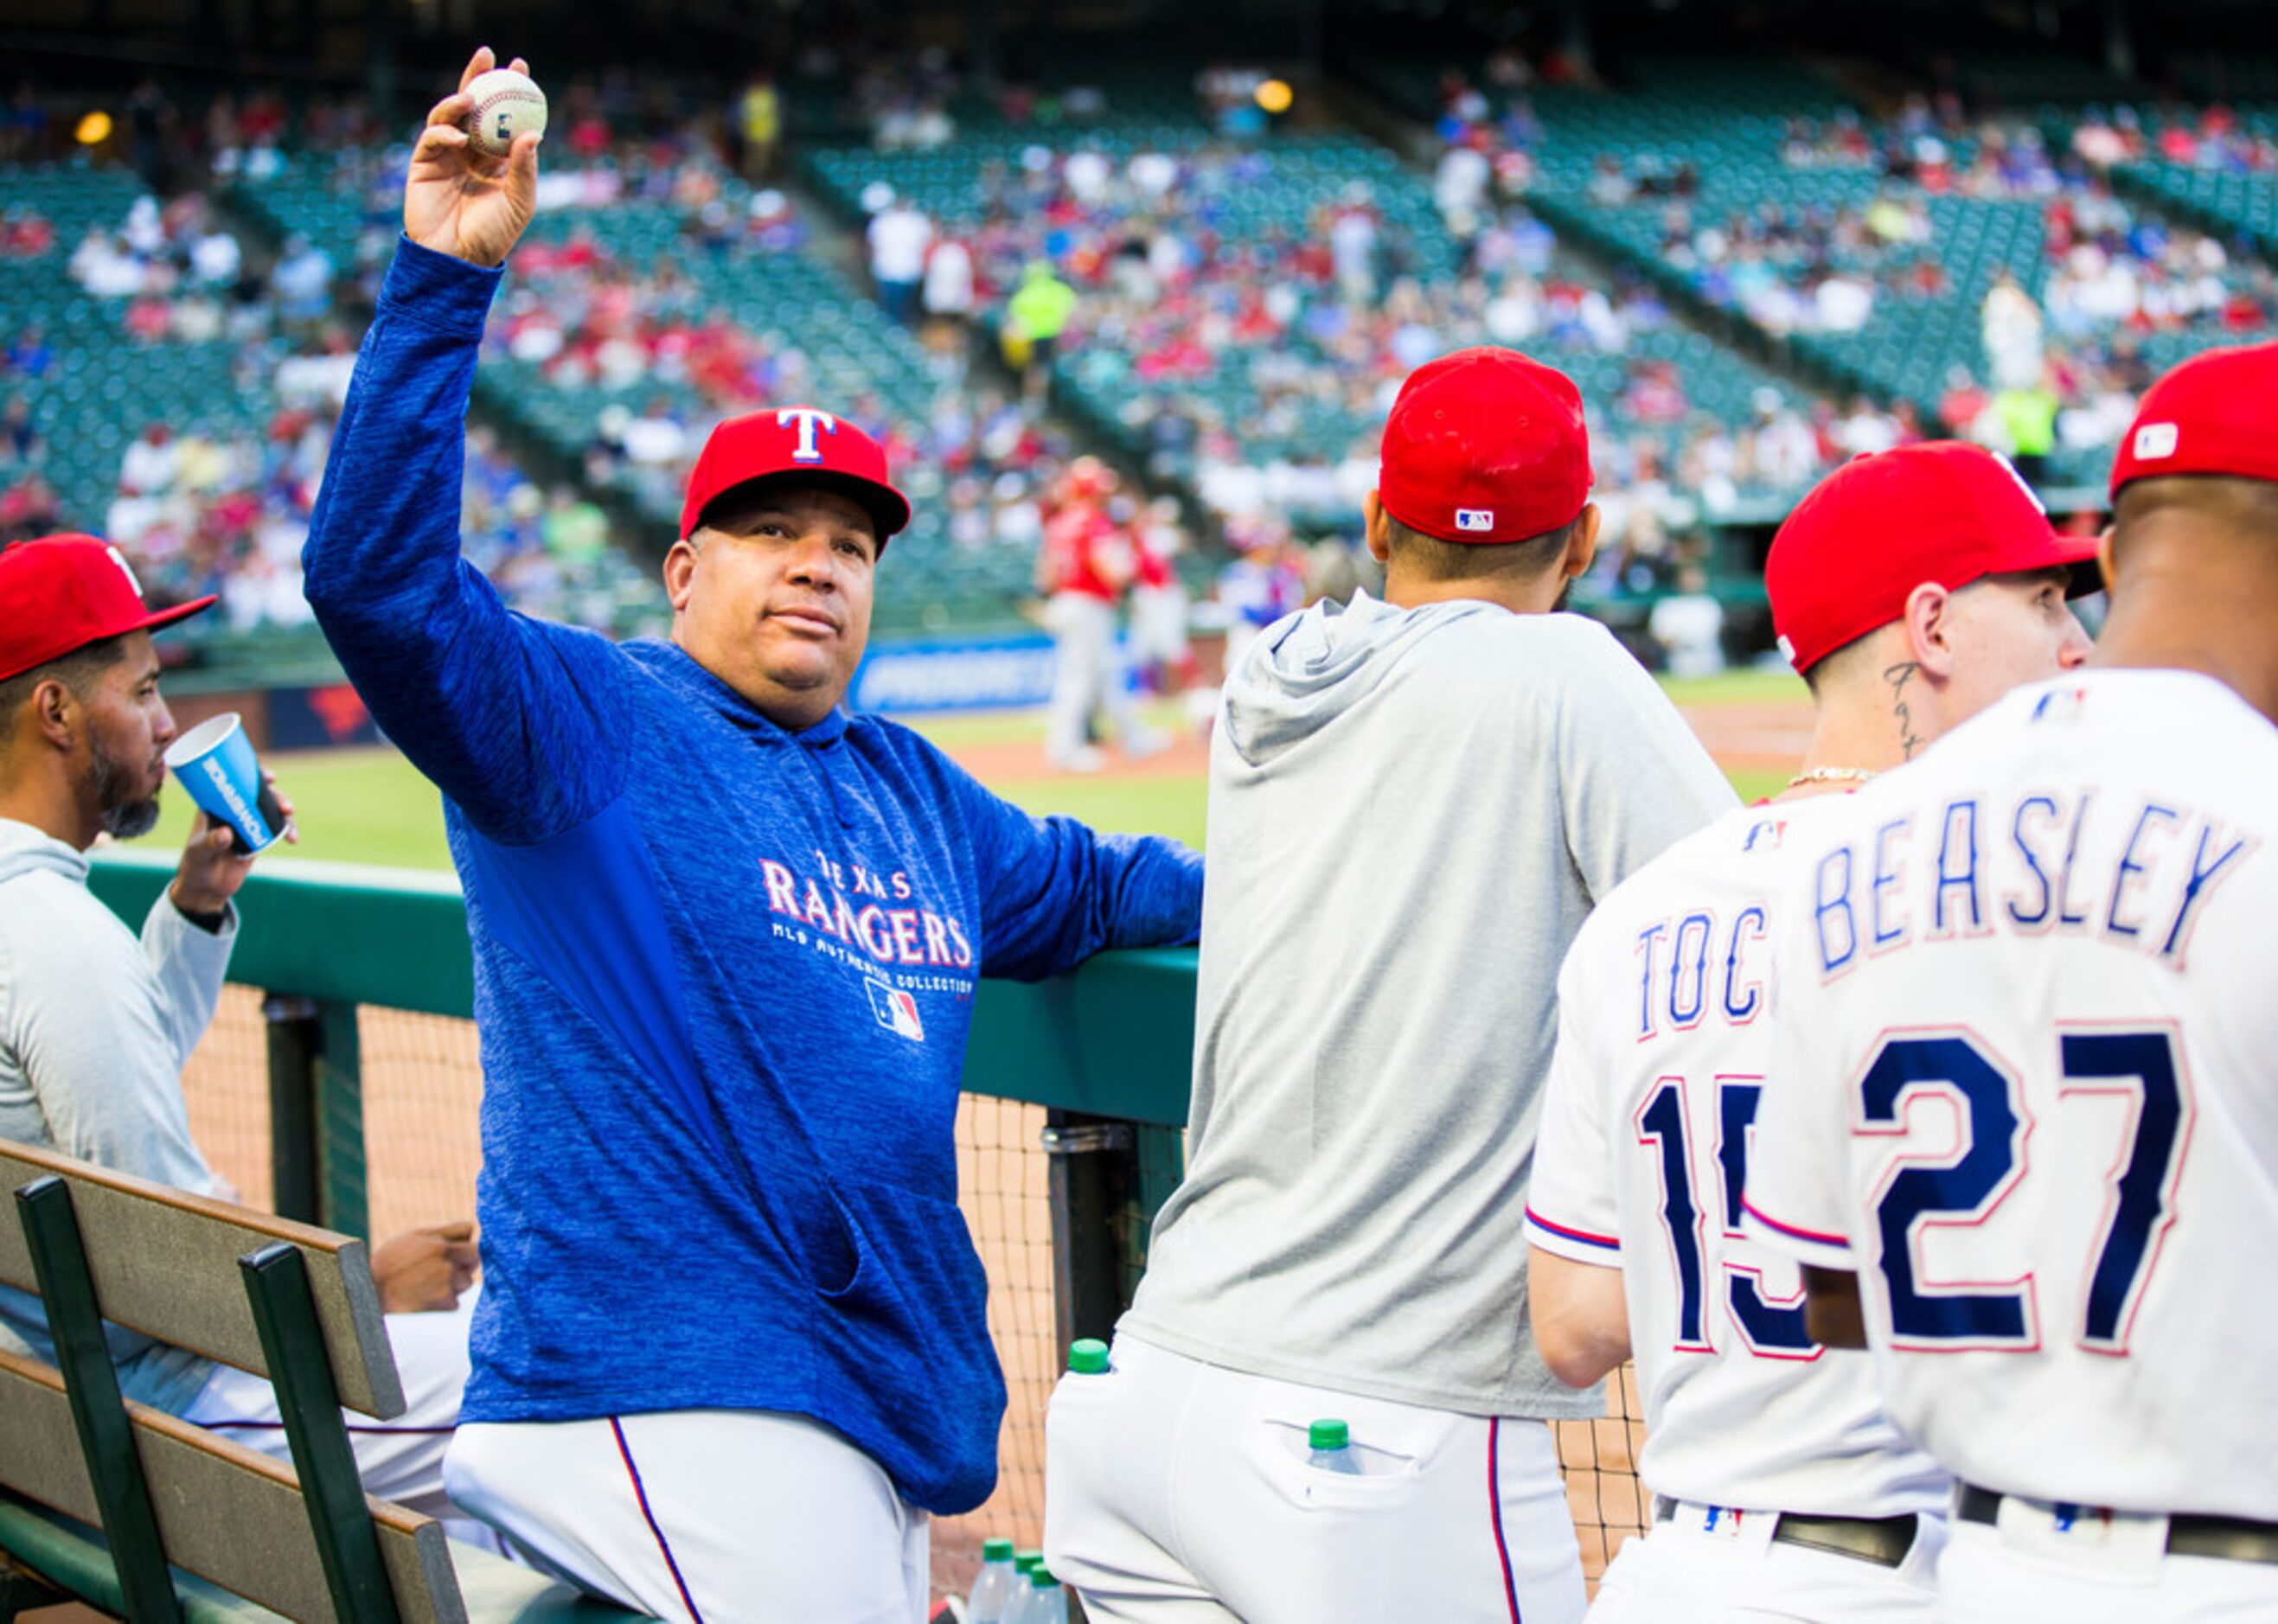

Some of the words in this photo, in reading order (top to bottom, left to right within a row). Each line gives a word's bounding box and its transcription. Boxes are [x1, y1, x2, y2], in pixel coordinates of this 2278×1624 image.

[777, 408, 836, 464] T
[758, 859, 971, 969] RANGERS
[815, 848, 911, 899] TEXAS
[1814, 789, 2257, 984] BEASLEY
[771, 923, 807, 945] MLB
[1633, 1075, 1827, 1362] 15
[1849, 1019, 2198, 1359] 27
